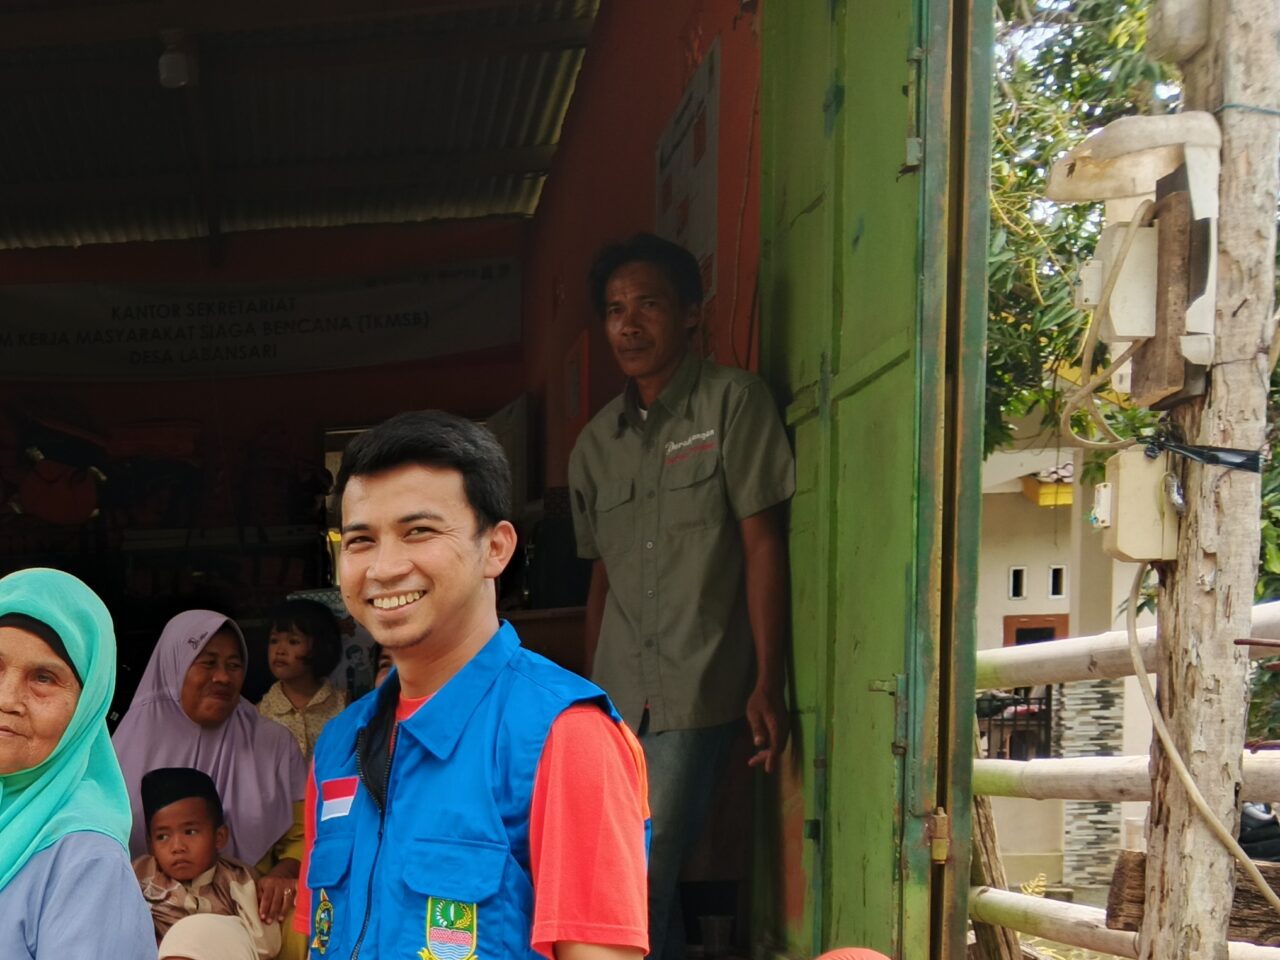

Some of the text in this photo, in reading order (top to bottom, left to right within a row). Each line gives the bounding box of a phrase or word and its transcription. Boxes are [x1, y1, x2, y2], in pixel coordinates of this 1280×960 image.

[110, 297, 296, 322] KANTOR SEKRETARIAT
[17, 329, 70, 348] KERJA
[74, 324, 195, 346] MASYARAKAT
[200, 322, 257, 342] SIAGA
[263, 316, 352, 337] BENCANA
[128, 348, 175, 367] DESA
